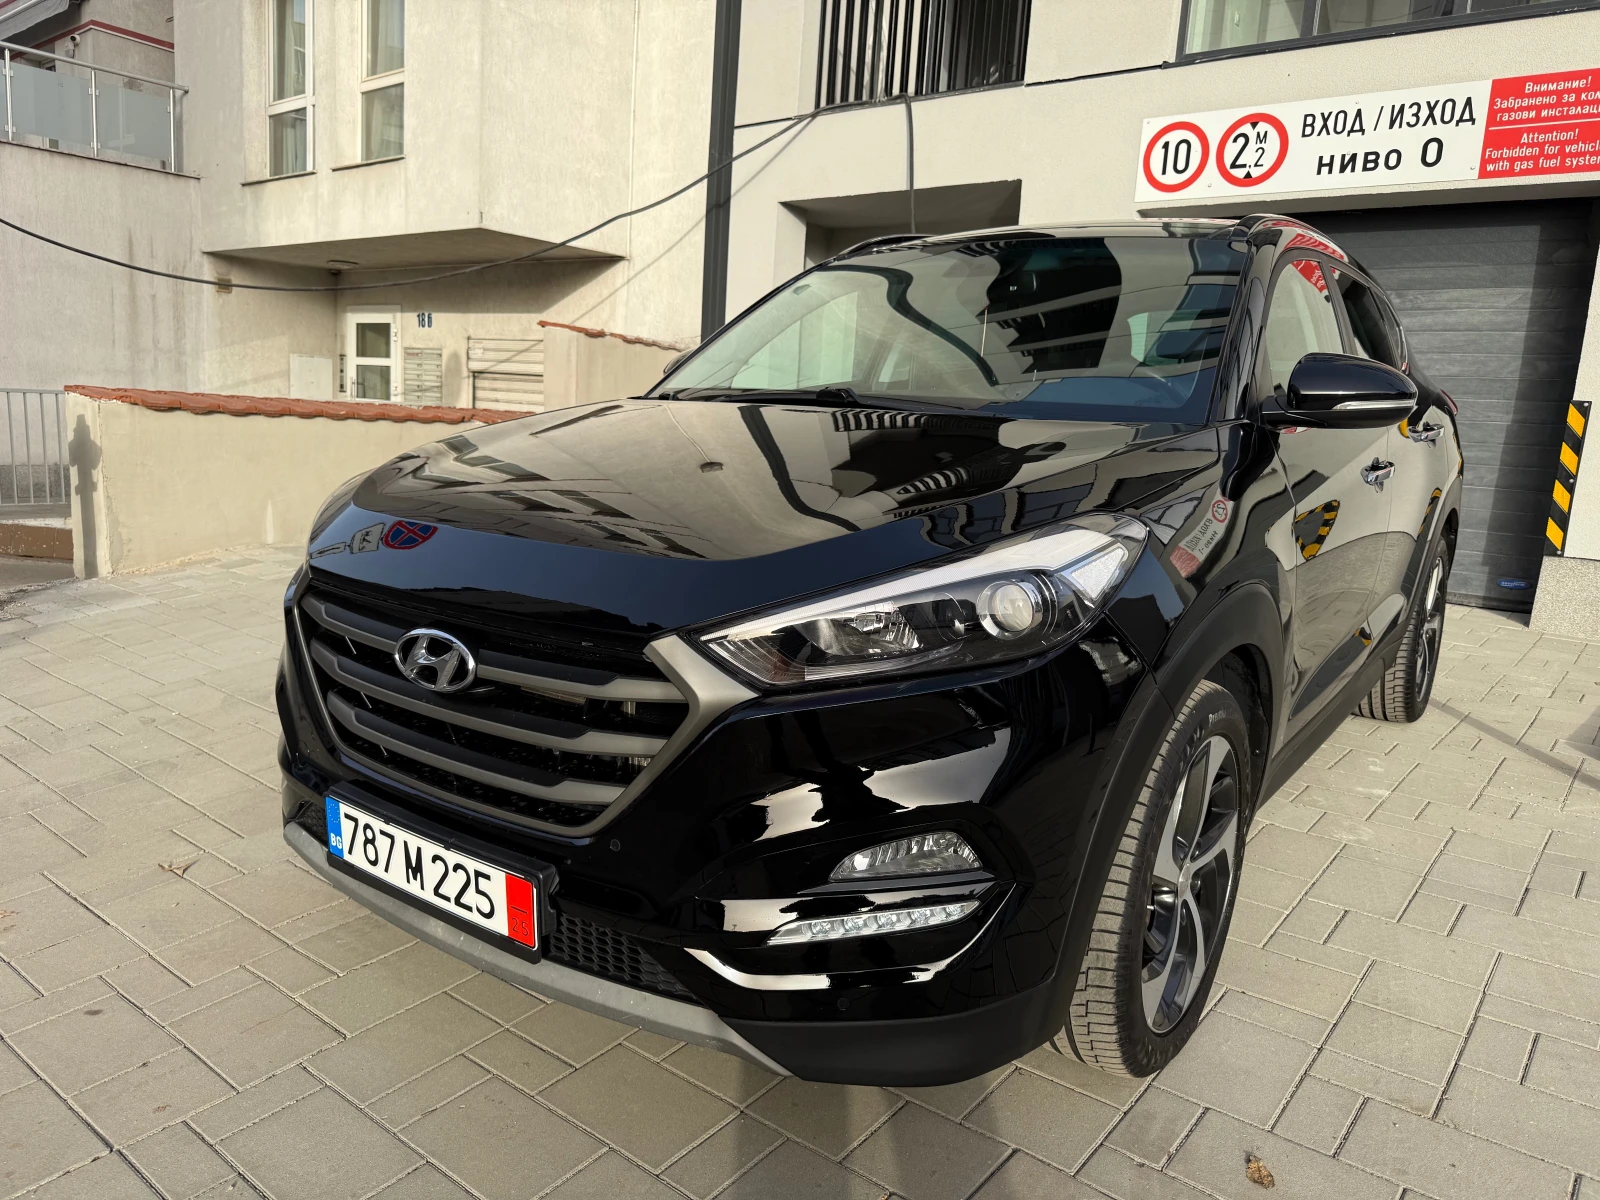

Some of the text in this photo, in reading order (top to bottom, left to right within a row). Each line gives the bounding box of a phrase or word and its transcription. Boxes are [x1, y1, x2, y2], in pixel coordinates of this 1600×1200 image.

[1525, 76, 1592, 93] Внимание!
[1493, 95, 1557, 110] Забранено
[1562, 93, 1576, 102] за
[1301, 108, 1366, 138] ВХОД
[1388, 96, 1476, 130] ИЗХОД
[1496, 109, 1536, 122] газови
[1520, 128, 1579, 144] Attention!
[1161, 138, 1192, 175] 10
[1485, 141, 1600, 159] Forbidden for vehicl
[1486, 160, 1510, 172] with
[1514, 160, 1534, 172] gas
[1539, 155, 1561, 168] fuel
[330, 832, 343, 850] BG
[343, 811, 496, 920] 787 M 225
[511, 917, 529, 937] 25
